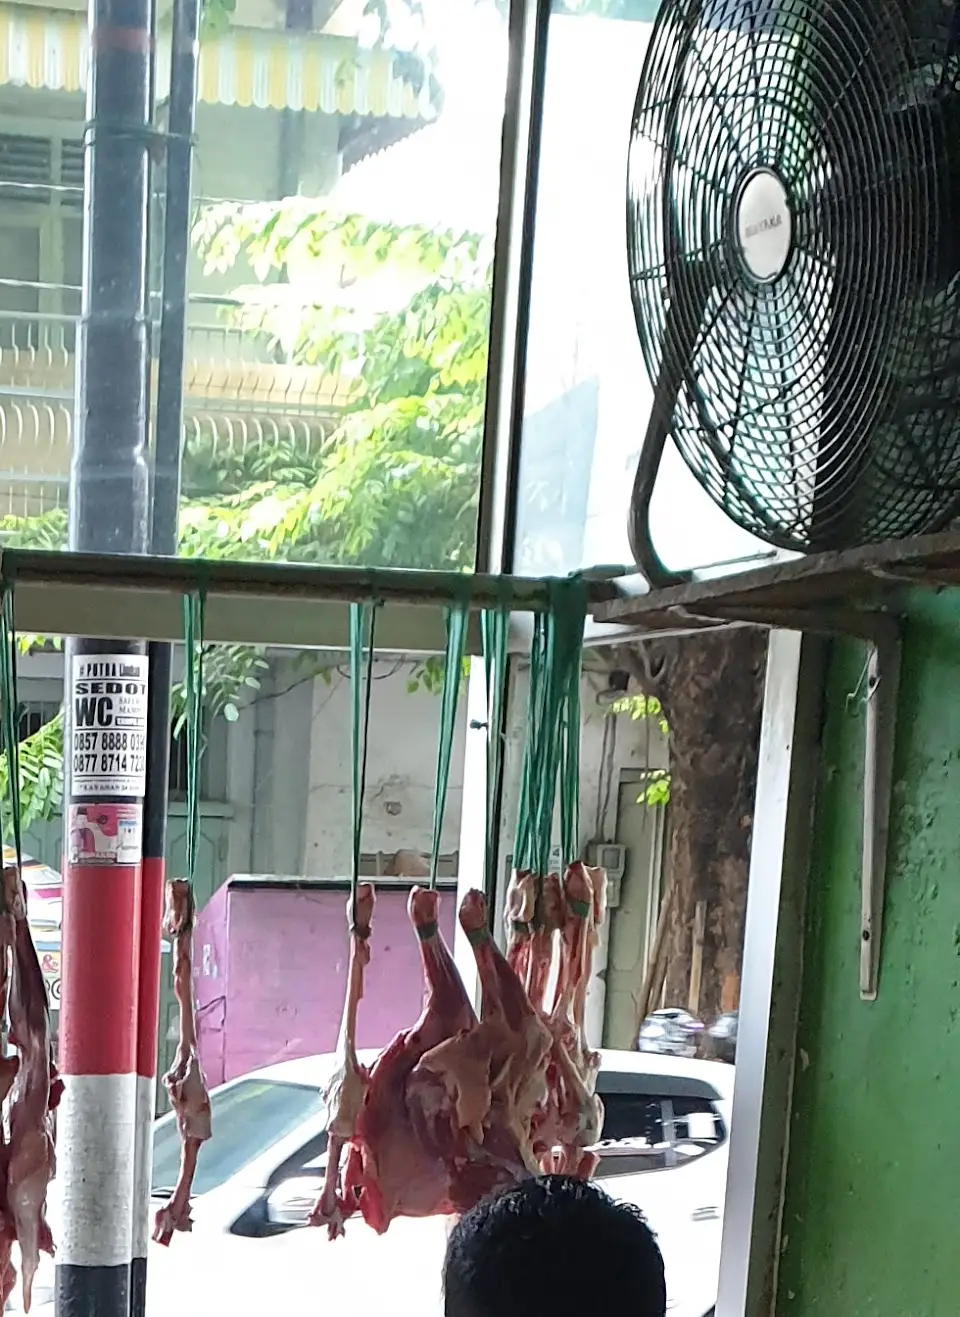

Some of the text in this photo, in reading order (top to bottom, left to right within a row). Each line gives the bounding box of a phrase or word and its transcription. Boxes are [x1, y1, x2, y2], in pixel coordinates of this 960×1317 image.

[75, 682, 146, 695] SEDOT
[75, 697, 113, 727] WC
[74, 732, 98, 751] 0857
[101, 732, 128, 751] 8888
[74, 754, 98, 772] 0877
[101, 754, 127, 772] 8714
